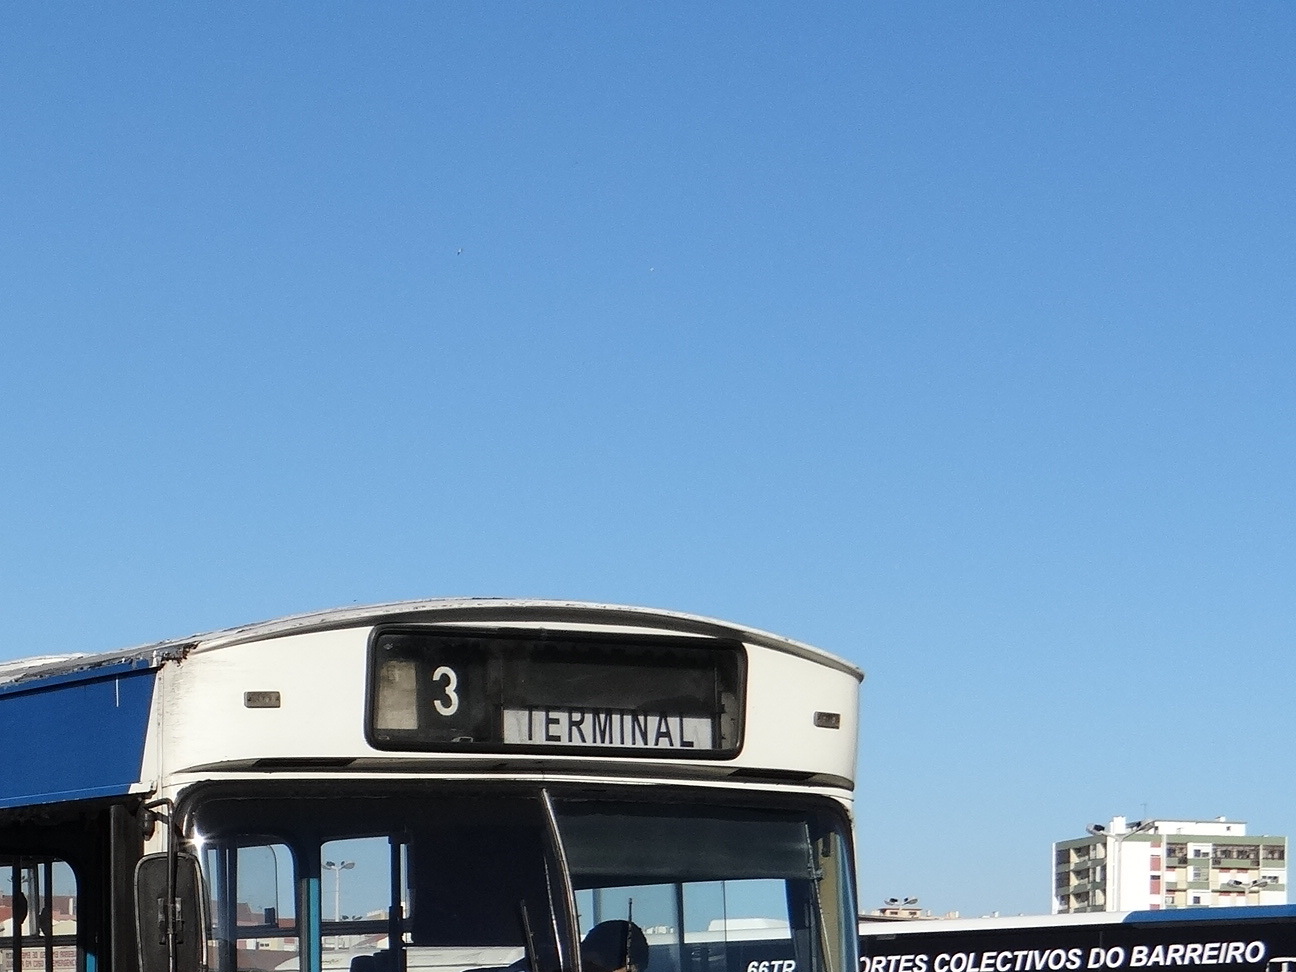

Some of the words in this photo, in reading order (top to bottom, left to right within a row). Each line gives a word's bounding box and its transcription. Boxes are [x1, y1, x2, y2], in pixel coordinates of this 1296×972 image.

[432, 666, 459, 716] 3
[525, 705, 695, 748] TERMINAL
[1087, 947, 1125, 969] DO
[1130, 941, 1265, 967] BARREIRO
